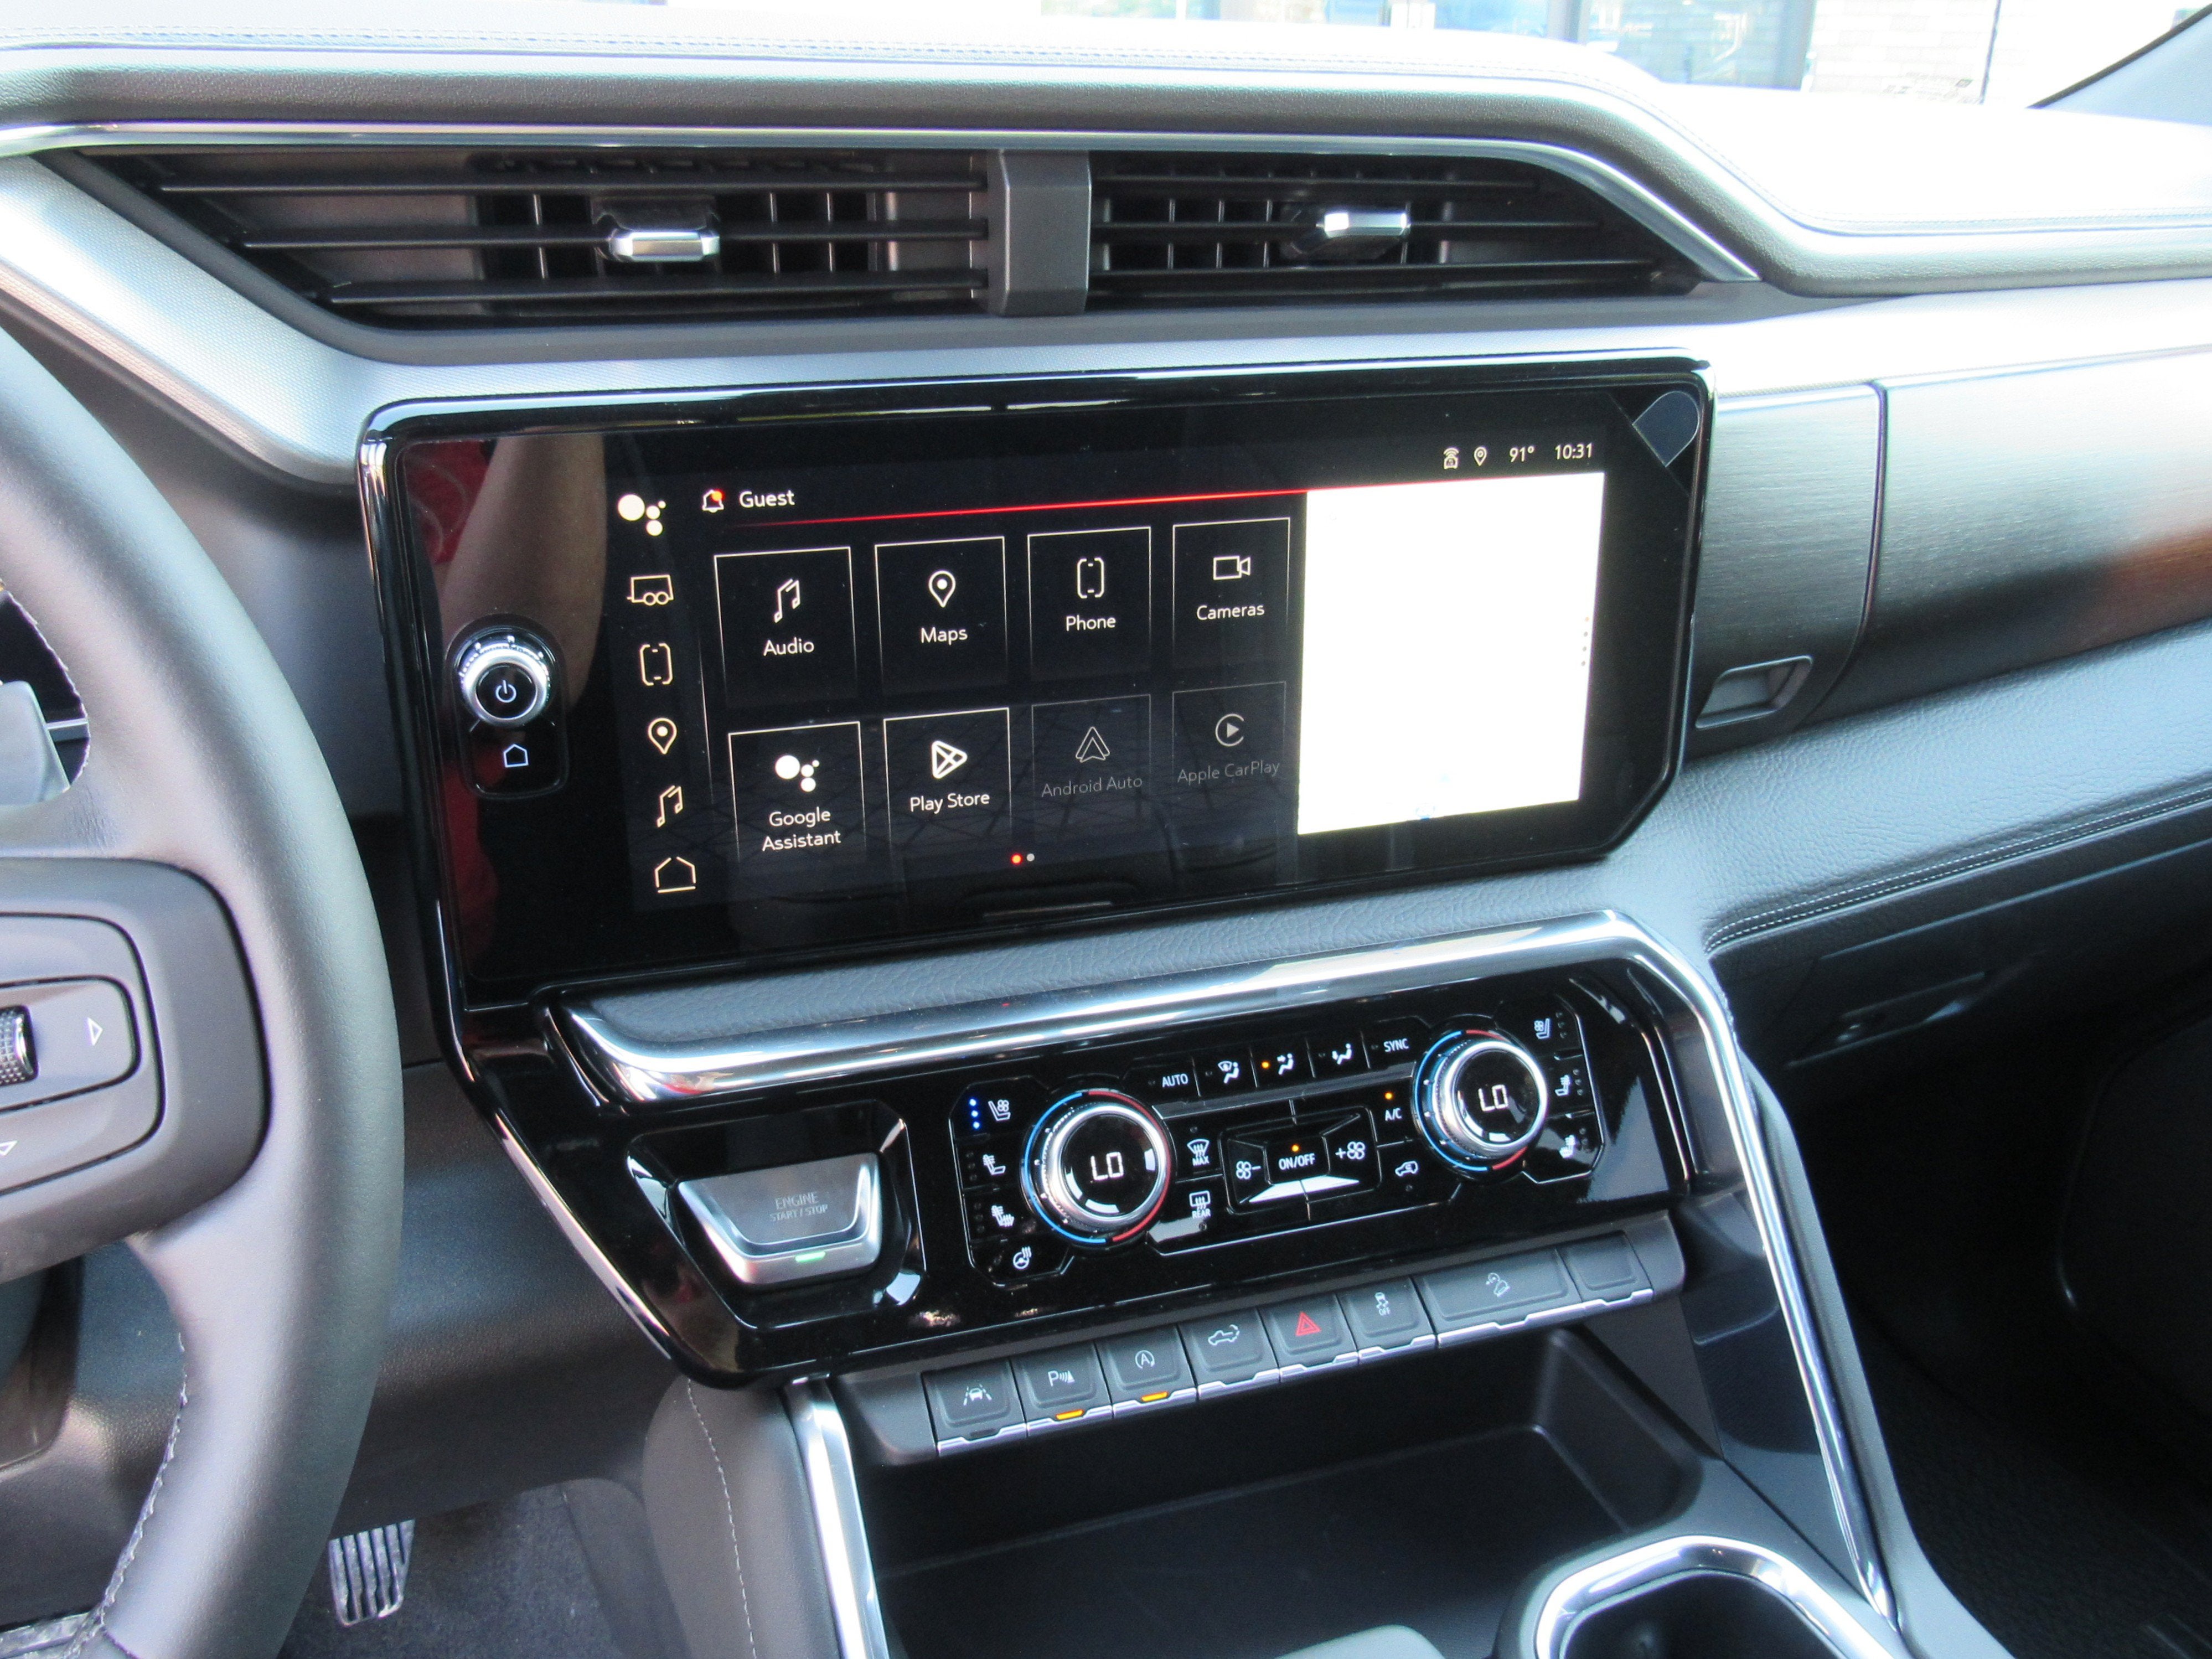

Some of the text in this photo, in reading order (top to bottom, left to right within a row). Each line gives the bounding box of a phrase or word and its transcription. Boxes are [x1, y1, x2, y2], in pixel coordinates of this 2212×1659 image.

[1554, 443, 1593, 461] 10:31
[739, 488, 795, 508] Guest
[1196, 604, 1265, 621] Cameras
[1066, 615, 1116, 632] Phone
[920, 626, 968, 645] Maps
[763, 637, 815, 656] Audio
[1177, 759, 1280, 784] Apple CarPlay
[1041, 776, 1143, 798] Android Auto
[909, 792, 990, 814] Play Store
[769, 806, 831, 830] Google
[762, 830, 841, 851] Assistant
[1383, 1037, 1409, 1053] SYNC
[1161, 1073, 1189, 1088] AUTO
[1384, 1107, 1403, 1121] A/C
[1192, 1155, 1210, 1166] MAX
[1278, 1152, 1316, 1170] ON/OFF
[776, 1191, 819, 1211] ENGINE
[1191, 1207, 1211, 1219] REAR
